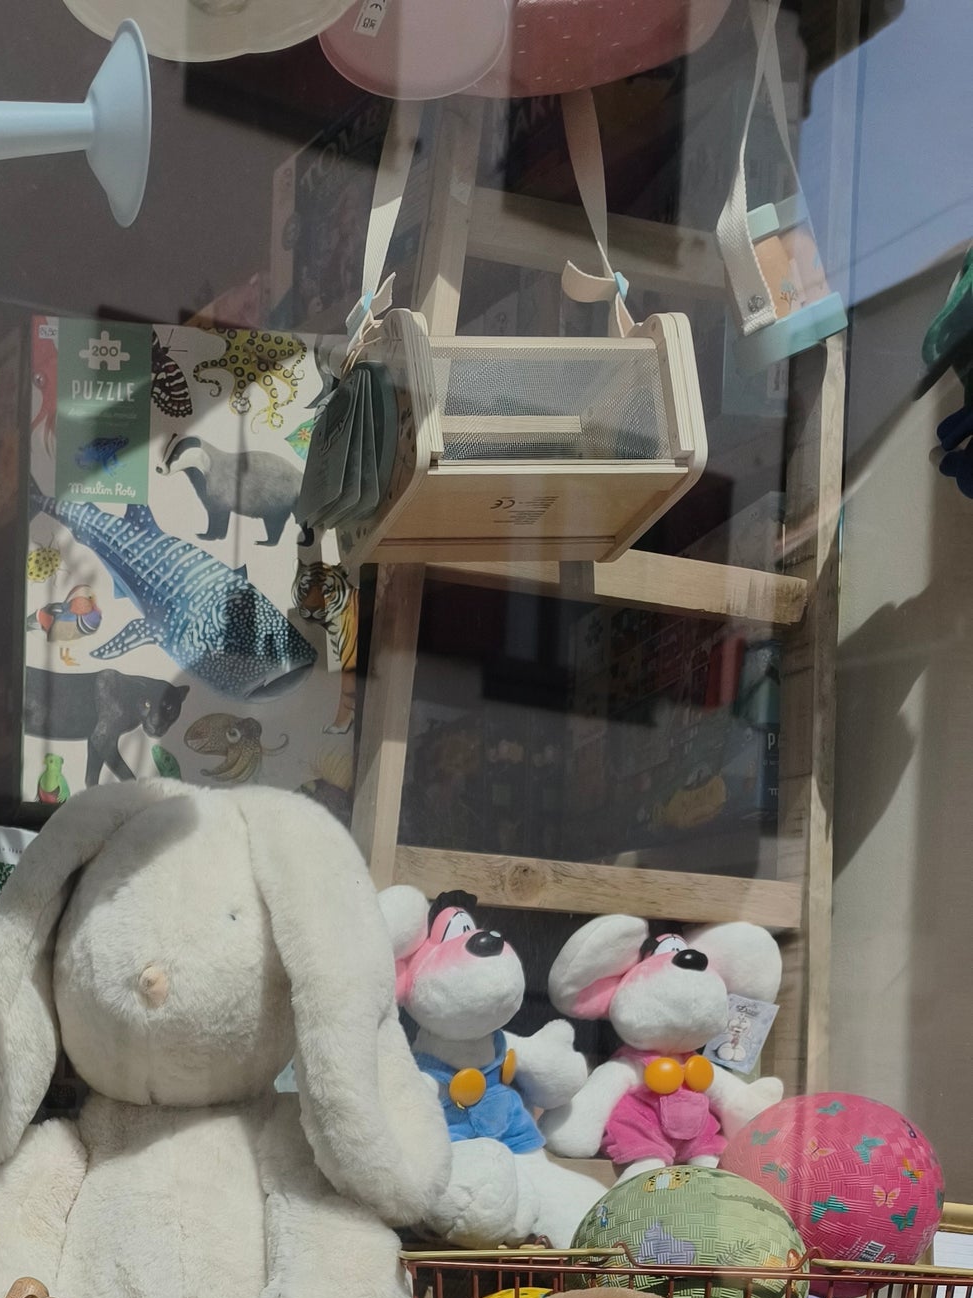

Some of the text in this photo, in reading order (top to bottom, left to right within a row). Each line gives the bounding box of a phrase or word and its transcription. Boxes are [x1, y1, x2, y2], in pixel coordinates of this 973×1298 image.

[92, 345, 119, 357] 200
[71, 379, 136, 402] PUZZLE
[68, 480, 137, 498] Moulin Roty
